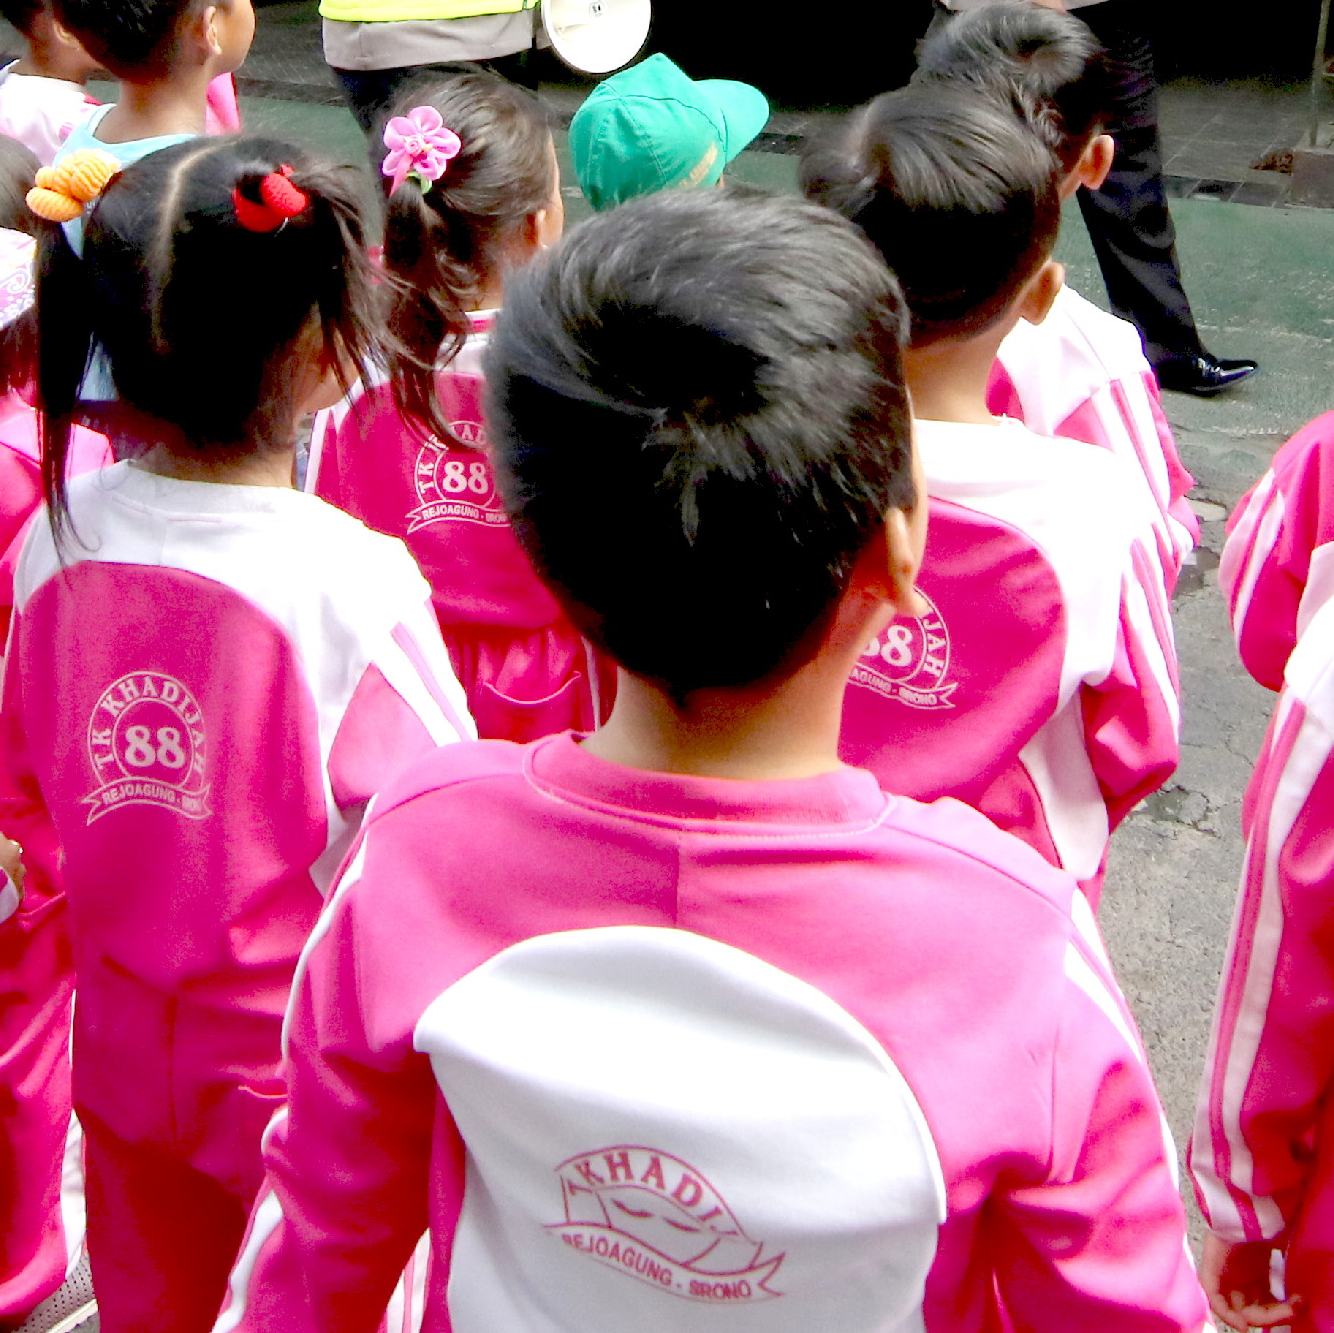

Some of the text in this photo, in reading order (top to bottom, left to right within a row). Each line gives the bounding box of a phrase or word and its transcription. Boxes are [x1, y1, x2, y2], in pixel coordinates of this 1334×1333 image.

[418, 462, 435, 494] TK
[442, 461, 489, 494] 88
[421, 505, 480, 520] REJOAGUNG
[851, 667, 893, 693] AGUNG
[92, 675, 205, 774] TK KHADIJAH
[124, 725, 186, 769] 88
[102, 783, 175, 805] REJOAGUNG
[574, 1151, 724, 1223] KHADI
[561, 1232, 673, 1287] REJOAGUNG
